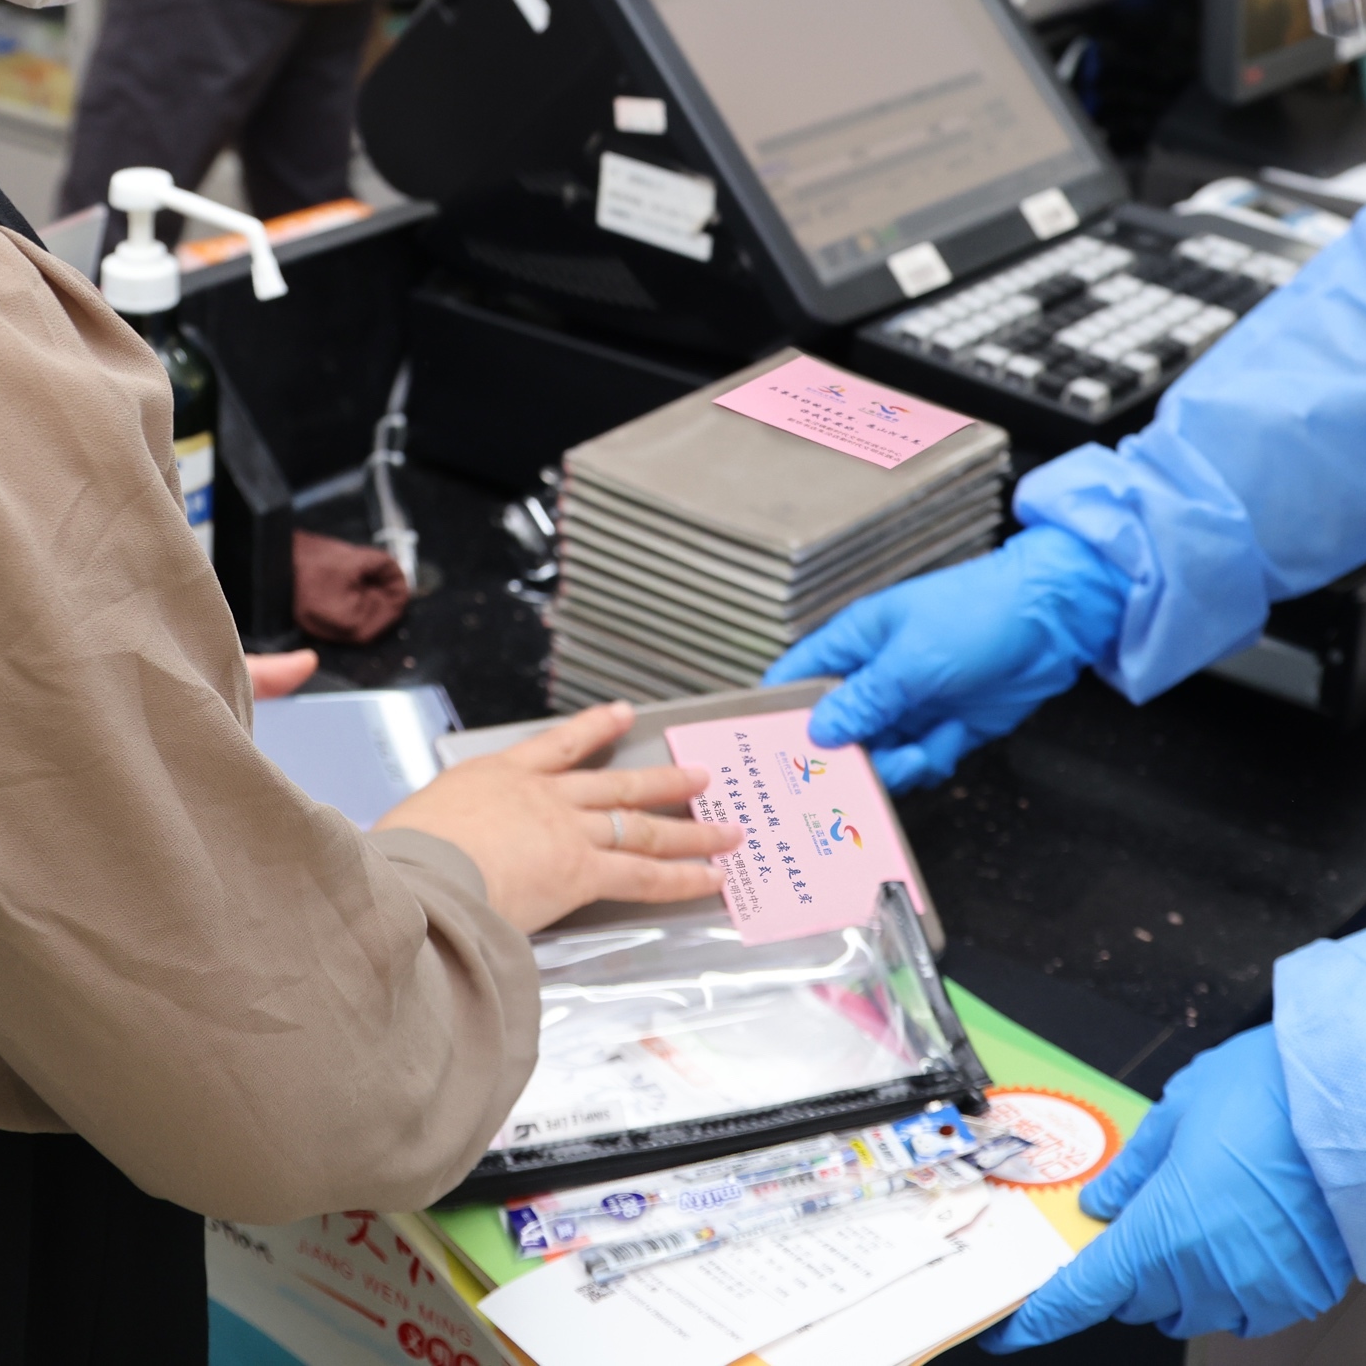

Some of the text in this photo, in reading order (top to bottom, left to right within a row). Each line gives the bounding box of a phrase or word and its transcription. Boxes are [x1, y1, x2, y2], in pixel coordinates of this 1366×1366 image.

[809, 811, 832, 856] 上海志愿者
[679, 1185, 741, 1210] miffy
[296, 1238, 355, 1279] JIANG
[362, 1272, 411, 1311] WEN
[418, 1304, 473, 1347] MING
